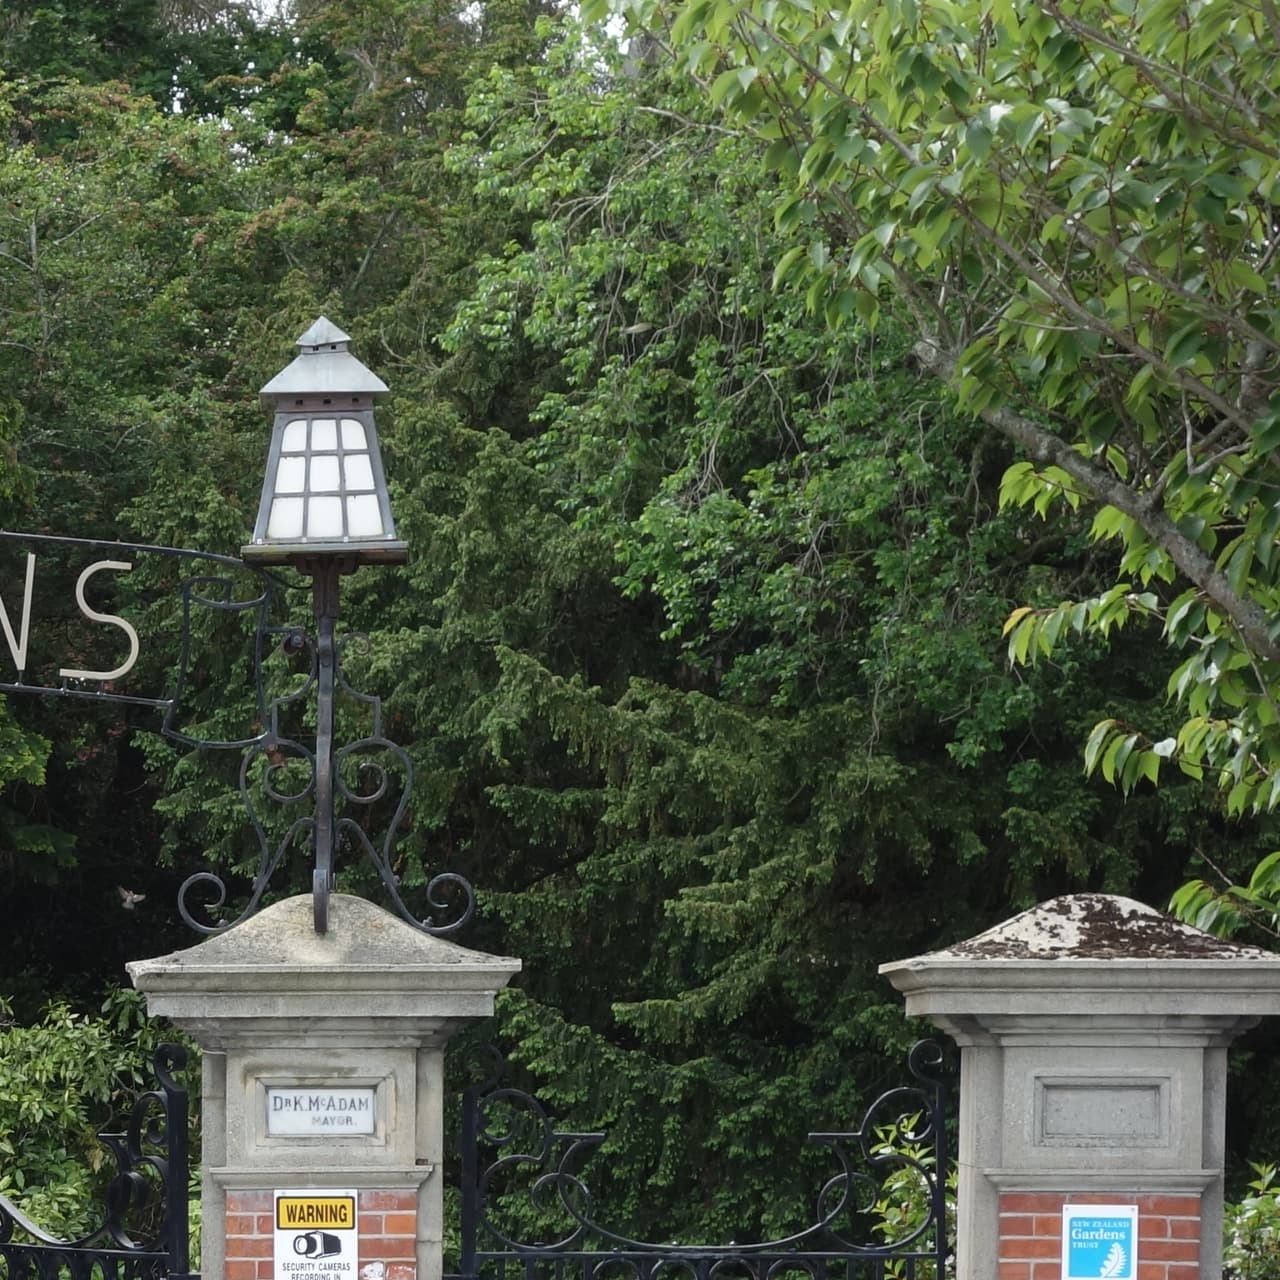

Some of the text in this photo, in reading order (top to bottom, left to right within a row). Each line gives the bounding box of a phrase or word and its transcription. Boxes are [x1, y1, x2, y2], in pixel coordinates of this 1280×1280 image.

[286, 1204, 347, 1223] WARNING
[1072, 1228, 1126, 1240] Gardens
[1072, 1241, 1099, 1249] TRUST
[282, 1262, 351, 1271] SECURITY CAMERAS
